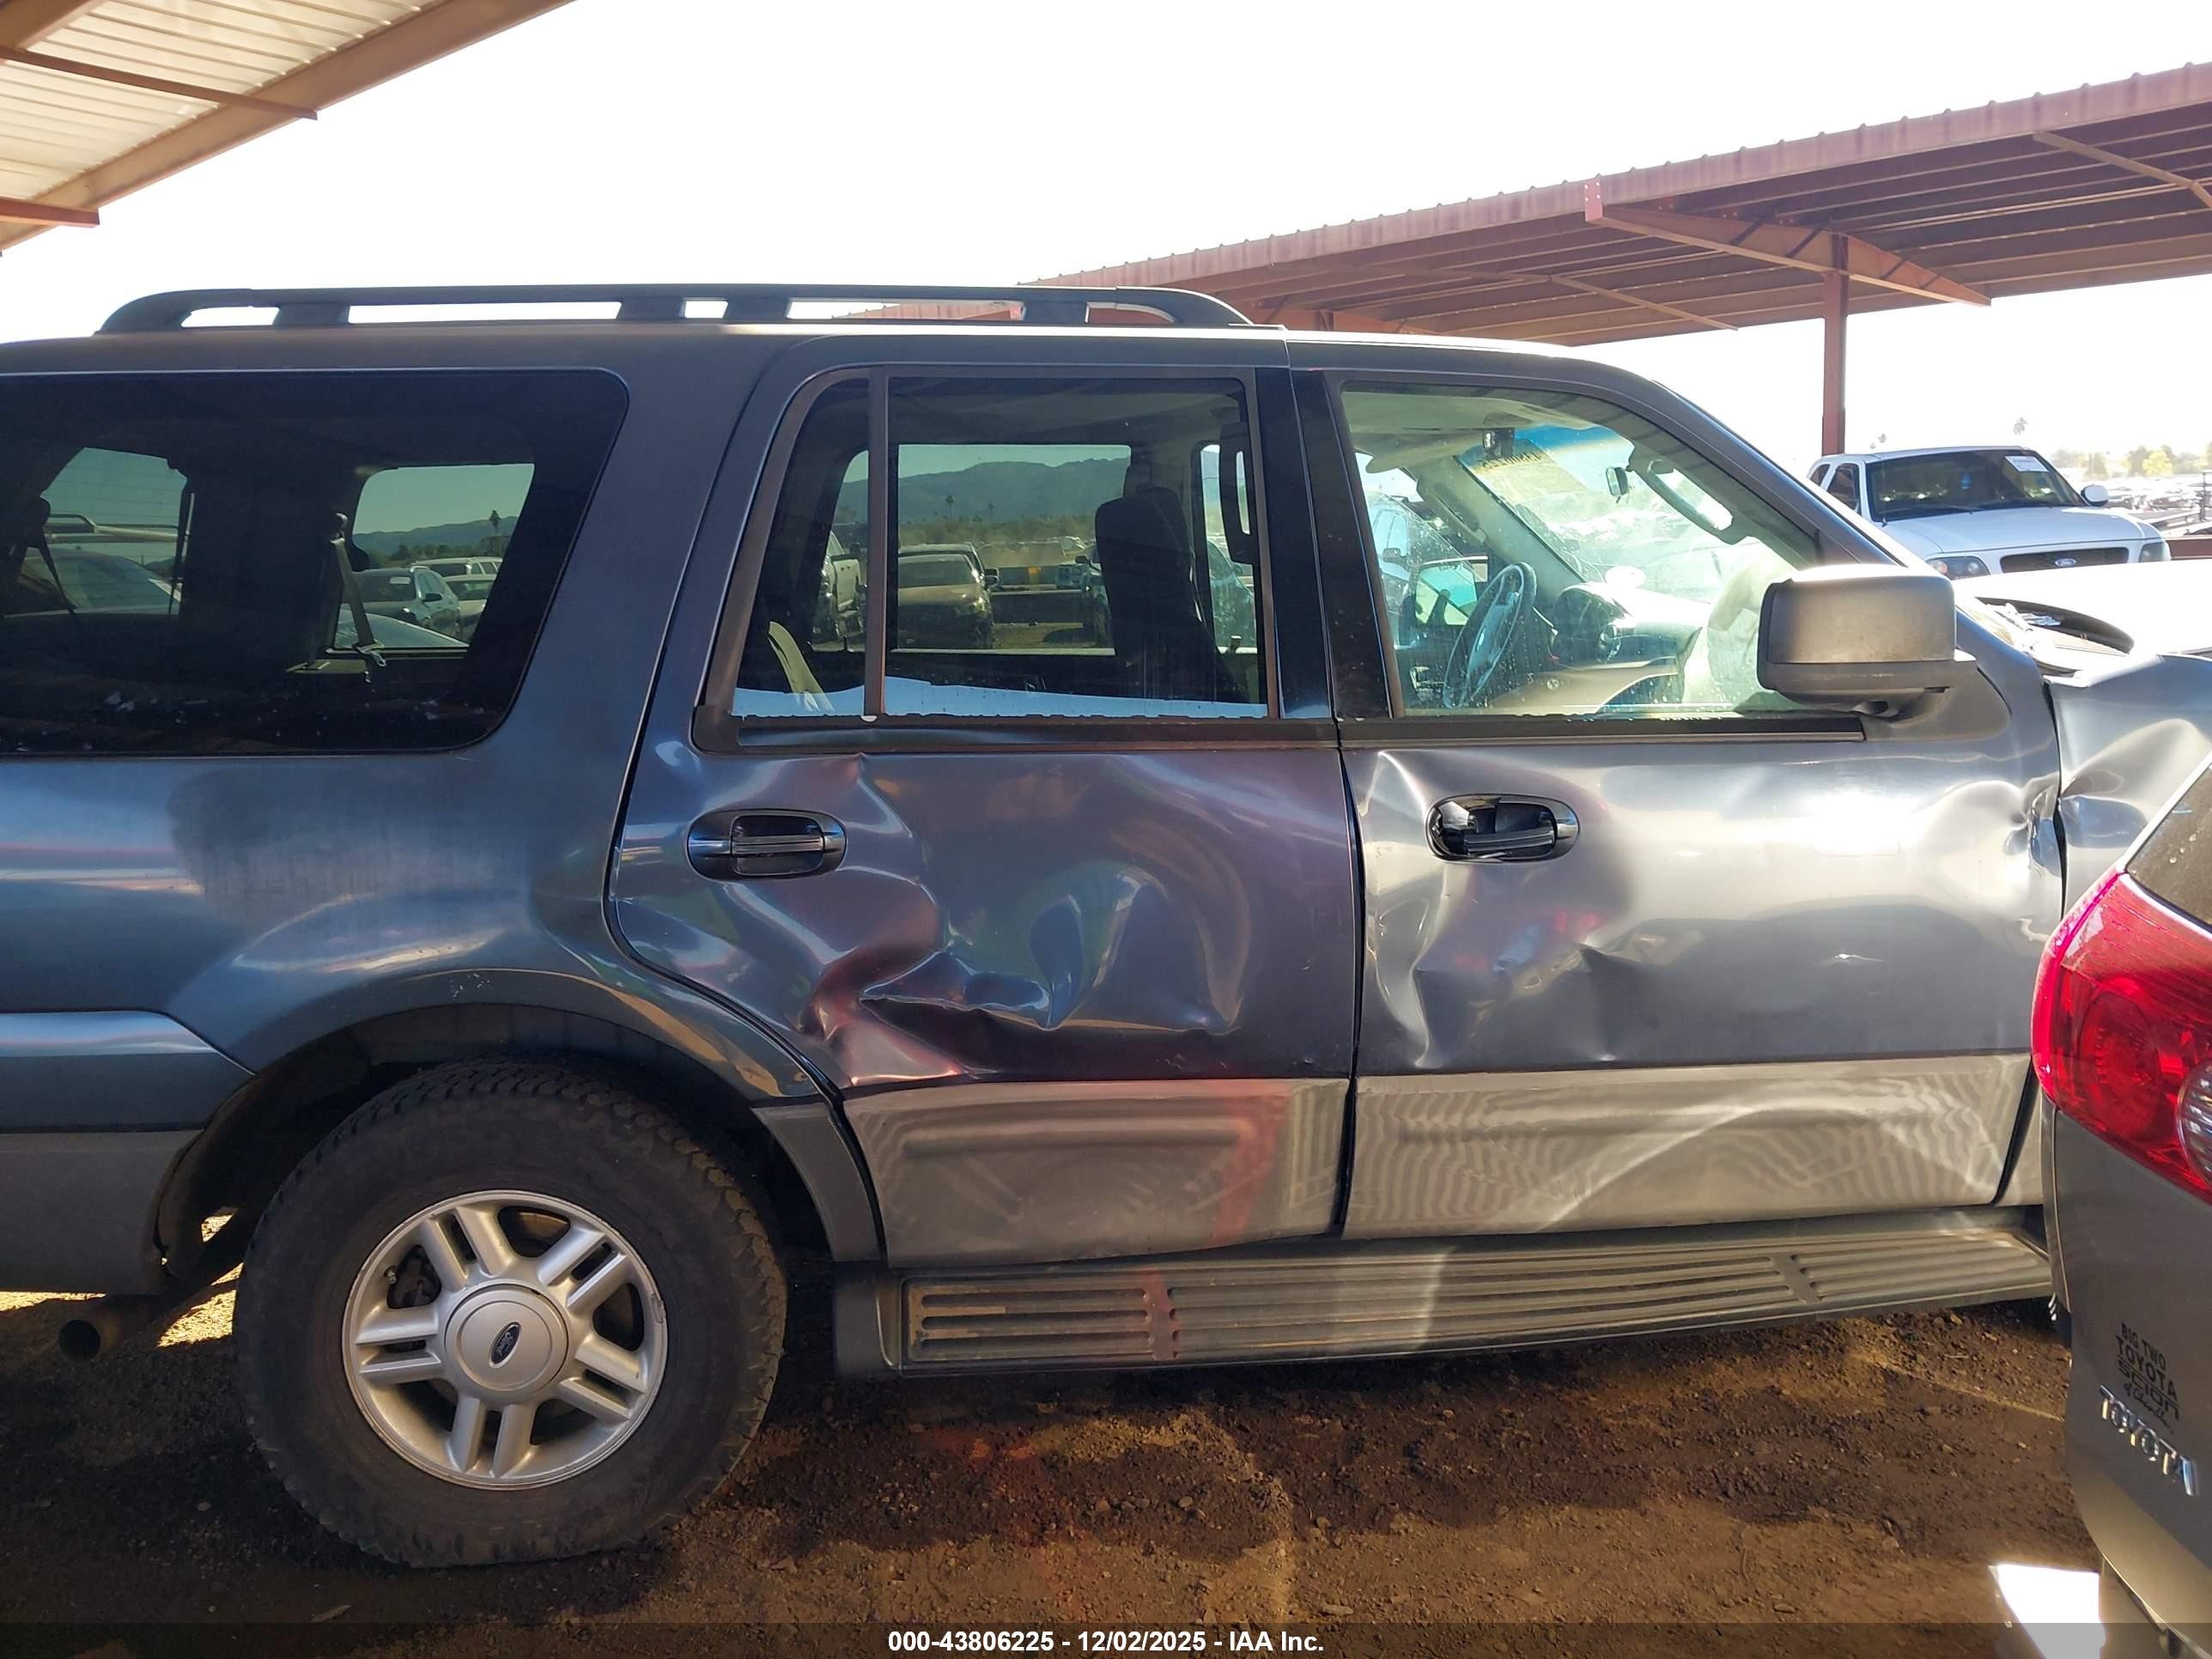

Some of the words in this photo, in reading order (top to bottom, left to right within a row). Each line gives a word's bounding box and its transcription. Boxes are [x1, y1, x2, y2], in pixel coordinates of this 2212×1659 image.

[2116, 1334, 2179, 1401] TOYOTA
[2121, 1322, 2139, 1348] BIG
[2142, 1338, 2166, 1371] TWO
